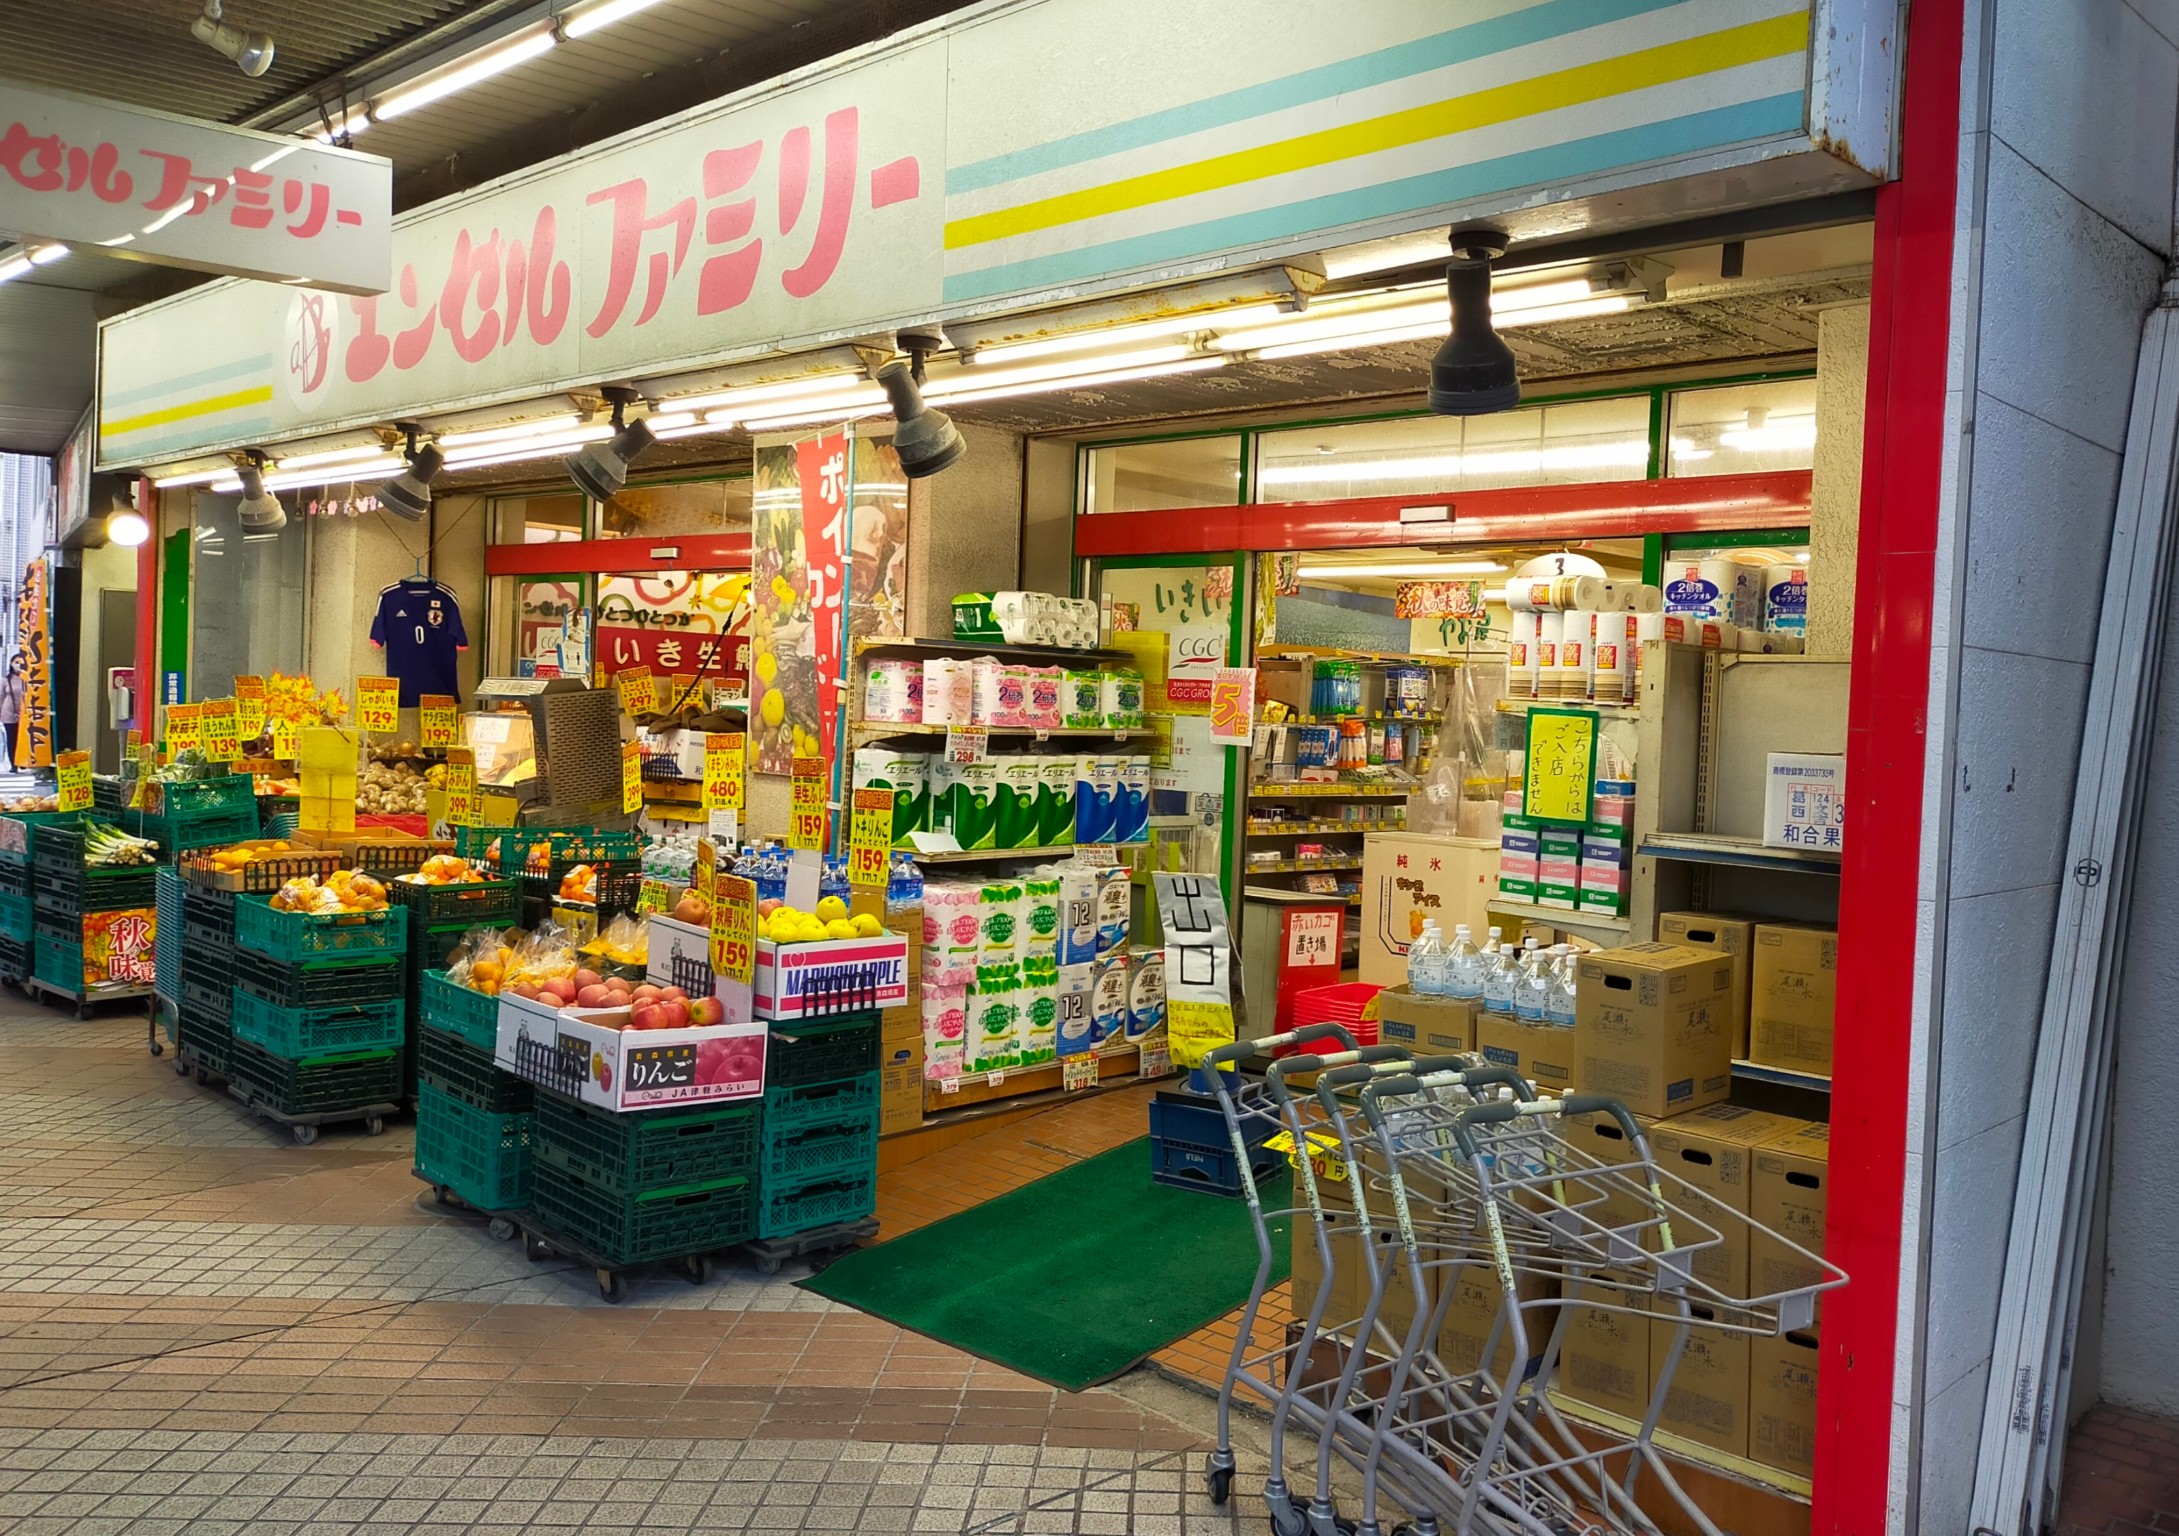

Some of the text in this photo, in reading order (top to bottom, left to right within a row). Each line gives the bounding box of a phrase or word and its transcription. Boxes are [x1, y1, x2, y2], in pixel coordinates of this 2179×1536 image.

[1669, 591, 1712, 601] キッチンタオル
[1677, 582, 1704, 593] 2倍巻
[1775, 594, 1806, 604] キッチンタ
[414, 625, 425, 645] 0
[1178, 637, 1220, 657] CGC
[361, 694, 396, 706] じゃがいも
[628, 694, 652, 708] 297
[363, 710, 392, 724] 129
[425, 728, 451, 741] 199
[211, 738, 238, 753] 139
[1550, 723, 1570, 776] ご入店
[956, 750, 975, 763] 298
[1566, 719, 1589, 815] こちらからは
[1530, 740, 1548, 815] できません
[66, 785, 90, 802] 128
[709, 780, 737, 797] 480
[793, 785, 825, 804] 早生ふじ
[449, 796, 467, 813] 399
[1813, 793, 1830, 803] 124
[797, 814, 823, 836] 159
[855, 816, 890, 838] トキりんご
[1783, 823, 1841, 847] 和合果
[855, 847, 884, 872] 159
[1396, 853, 1442, 871] 純氷
[1396, 877, 1424, 892] キング
[1412, 892, 1442, 908] アイス
[1072, 901, 1090, 926] 12
[1171, 877, 1215, 986] 出口
[1292, 914, 1336, 932] 赤いカゴ
[716, 939, 748, 968] 159
[1295, 934, 1327, 956] 置き場
[1062, 994, 1082, 1021] 12
[635, 1048, 690, 1061] 青森県産
[632, 1059, 694, 1088] りんご
[671, 1082, 745, 1099] JA津軽みらい
